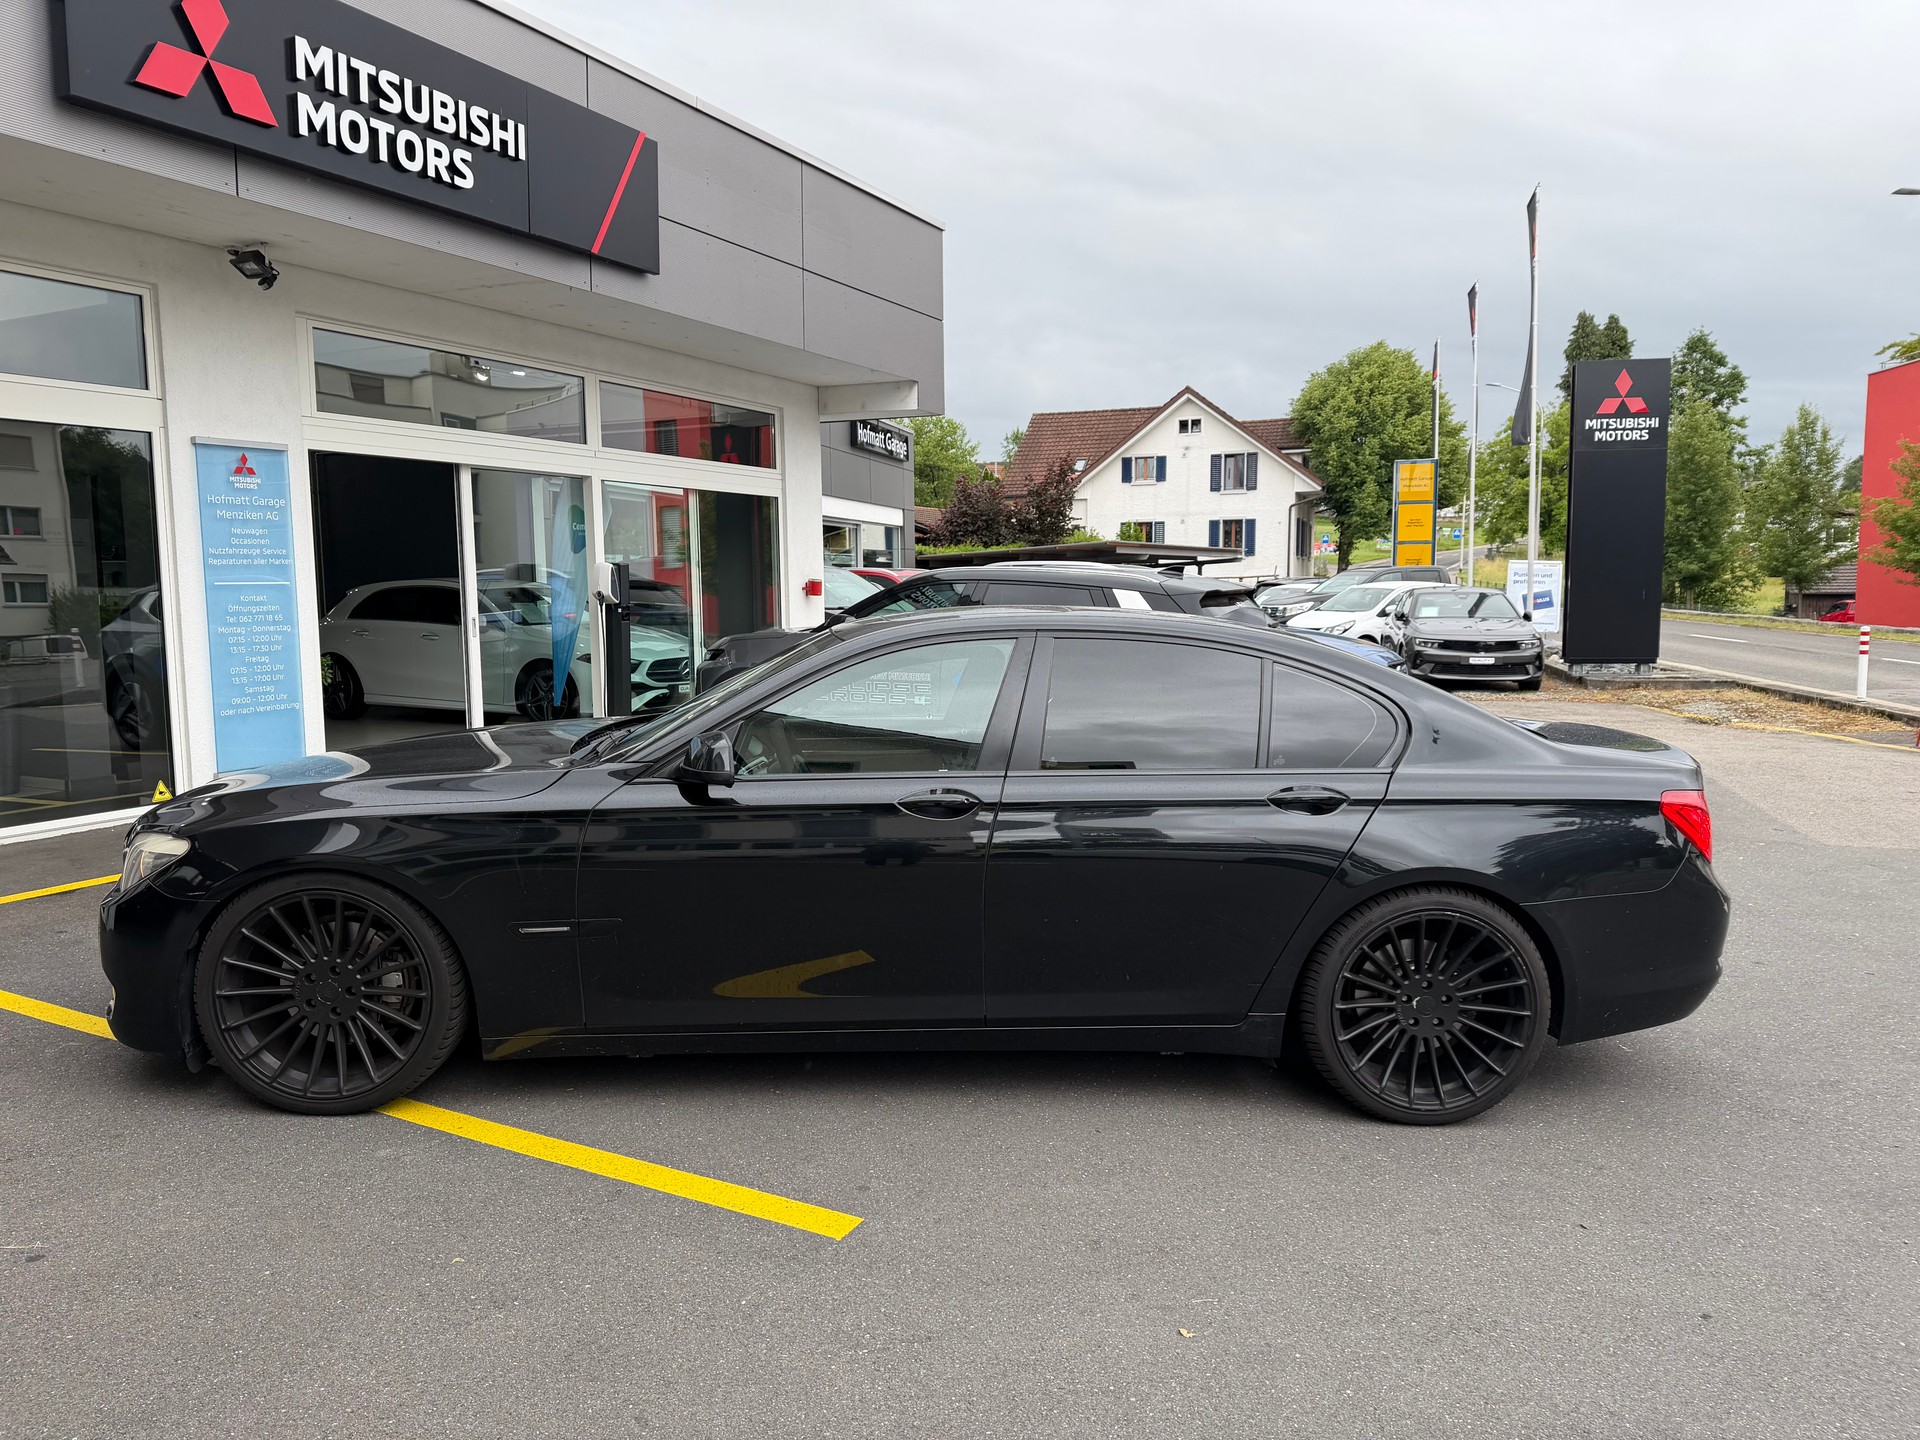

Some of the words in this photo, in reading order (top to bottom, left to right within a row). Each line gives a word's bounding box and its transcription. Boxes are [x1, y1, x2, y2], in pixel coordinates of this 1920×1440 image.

[294, 35, 526, 161] MITSUBISHI
[297, 91, 475, 189] MOTORS
[1584, 417, 1660, 430] MITSUBISHI
[857, 421, 886, 449] Hofmatt
[886, 432, 907, 459] Garage
[1594, 430, 1649, 441] MOTORS
[229, 476, 262, 484] MITSUBISHI
[207, 494, 250, 505] Hofmatt
[252, 496, 286, 508] Garage
[216, 509, 263, 520] Menziken
[266, 511, 279, 521] AG
[231, 527, 268, 536] Neuwagen
[230, 537, 270, 545] Occasionen
[208, 547, 260, 555] Nutzfahrzeuge
[262, 547, 286, 555] Service
[208, 557, 252, 566] Reparaturen
[239, 615, 252, 623] 062
[253, 614, 265, 622] 771
[274, 613, 283, 621] 65
[218, 626, 245, 635] Montag
[252, 624, 291, 633] Donnerstag
[228, 636, 245, 644] 07:15
[252, 634, 269, 643] 12:00
[270, 634, 283, 642] Uhr
[245, 655, 270, 663] Freitag
[254, 665, 271, 673] 12:00
[888, 671, 931, 681] MITSUBISHI
[244, 685, 275, 694] Samstag
[833, 680, 931, 694] LIPSE
[231, 697, 251, 705] 09:00
[257, 695, 275, 703] 12:00
[220, 709, 236, 717] oder
[237, 707, 254, 715] nach
[256, 702, 300, 712] Vereinbarung
